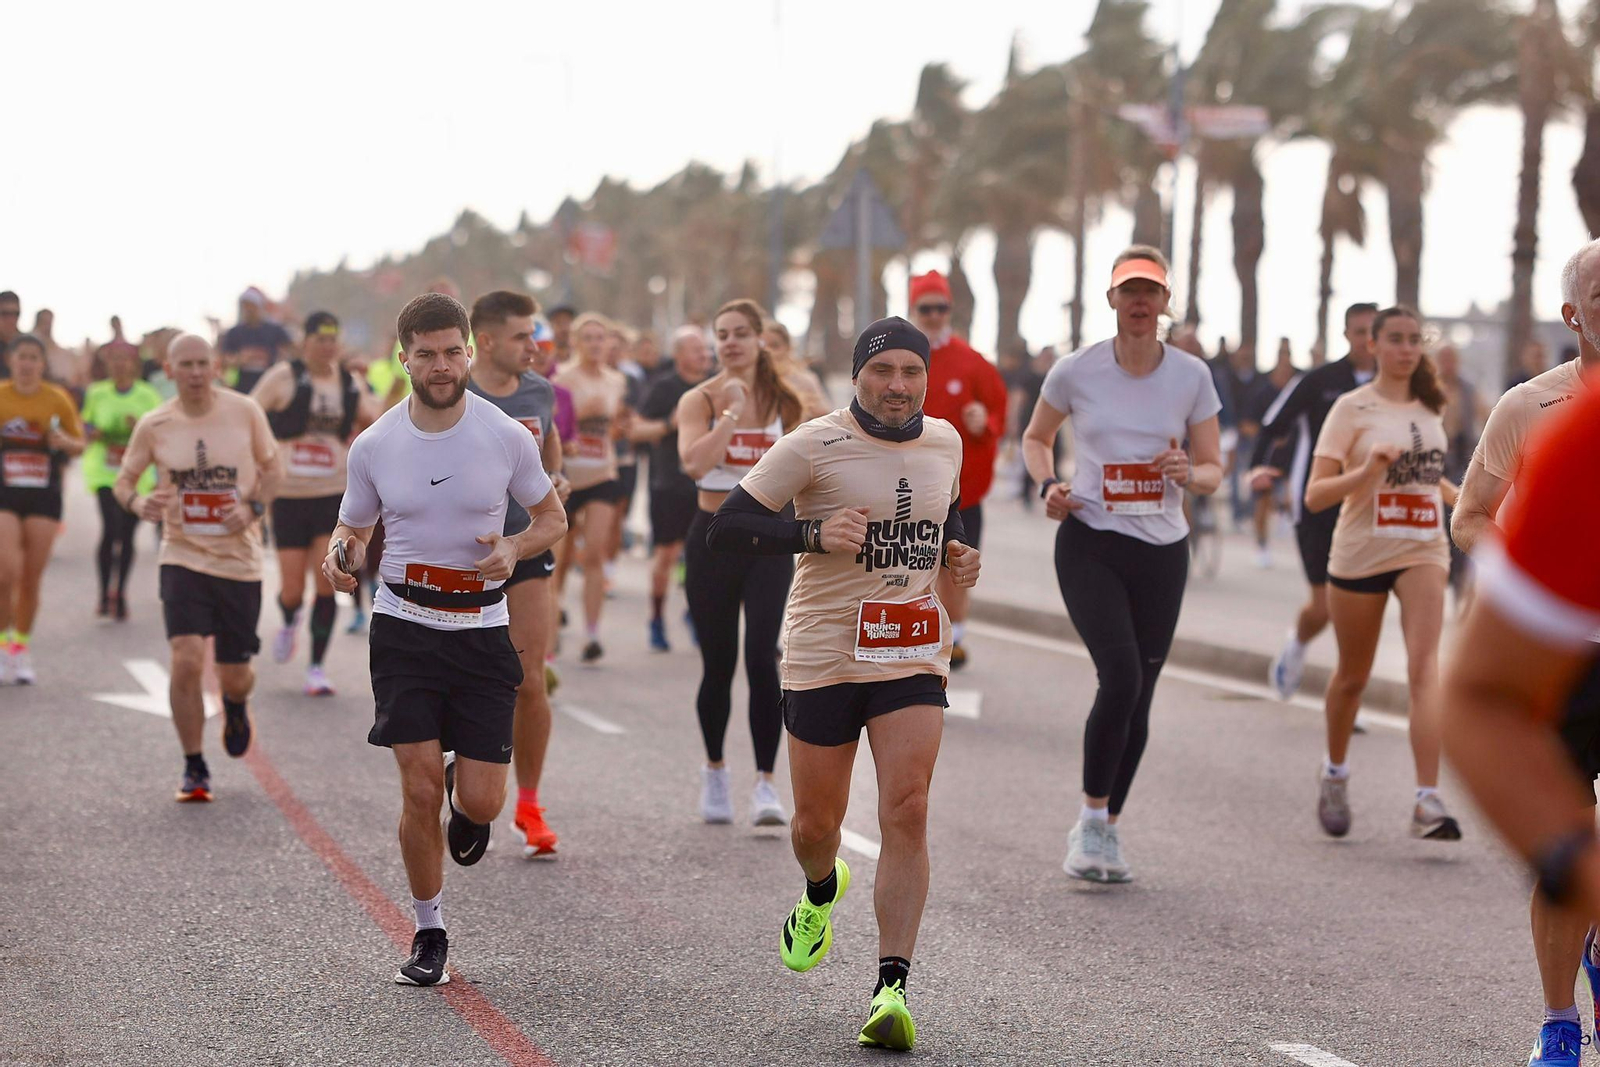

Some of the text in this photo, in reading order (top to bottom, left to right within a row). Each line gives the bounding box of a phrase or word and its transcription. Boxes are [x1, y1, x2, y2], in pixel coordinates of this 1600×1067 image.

[1539, 396, 1565, 408] luanvi
[823, 436, 845, 447] luanvi
[865, 519, 941, 547] RUNCH
[855, 541, 909, 573] RUN
[908, 555, 937, 571] 2025
[863, 621, 901, 633] BRUNCH
[911, 619, 928, 637] 21
[867, 629, 885, 640] RUN
